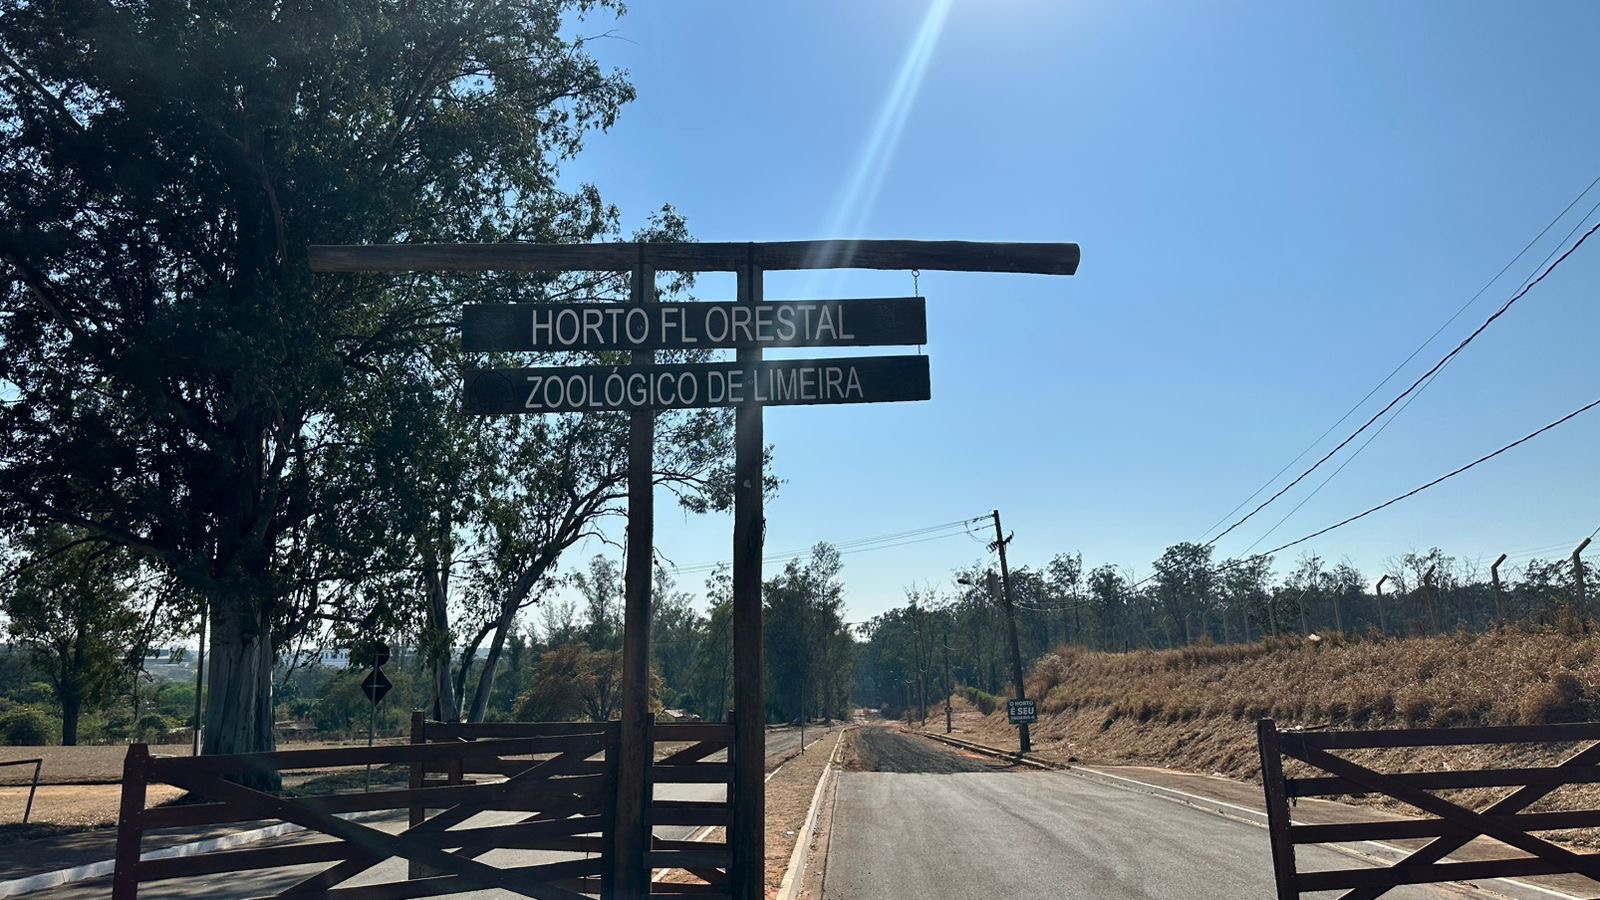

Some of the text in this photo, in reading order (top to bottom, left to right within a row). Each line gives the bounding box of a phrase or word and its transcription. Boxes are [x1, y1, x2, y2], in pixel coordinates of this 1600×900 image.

[531, 307, 650, 346] HORTO
[525, 365, 864, 409] ZOOLÓGICO DE LIMEIRA
[1010, 706, 1035, 715] É SEU
